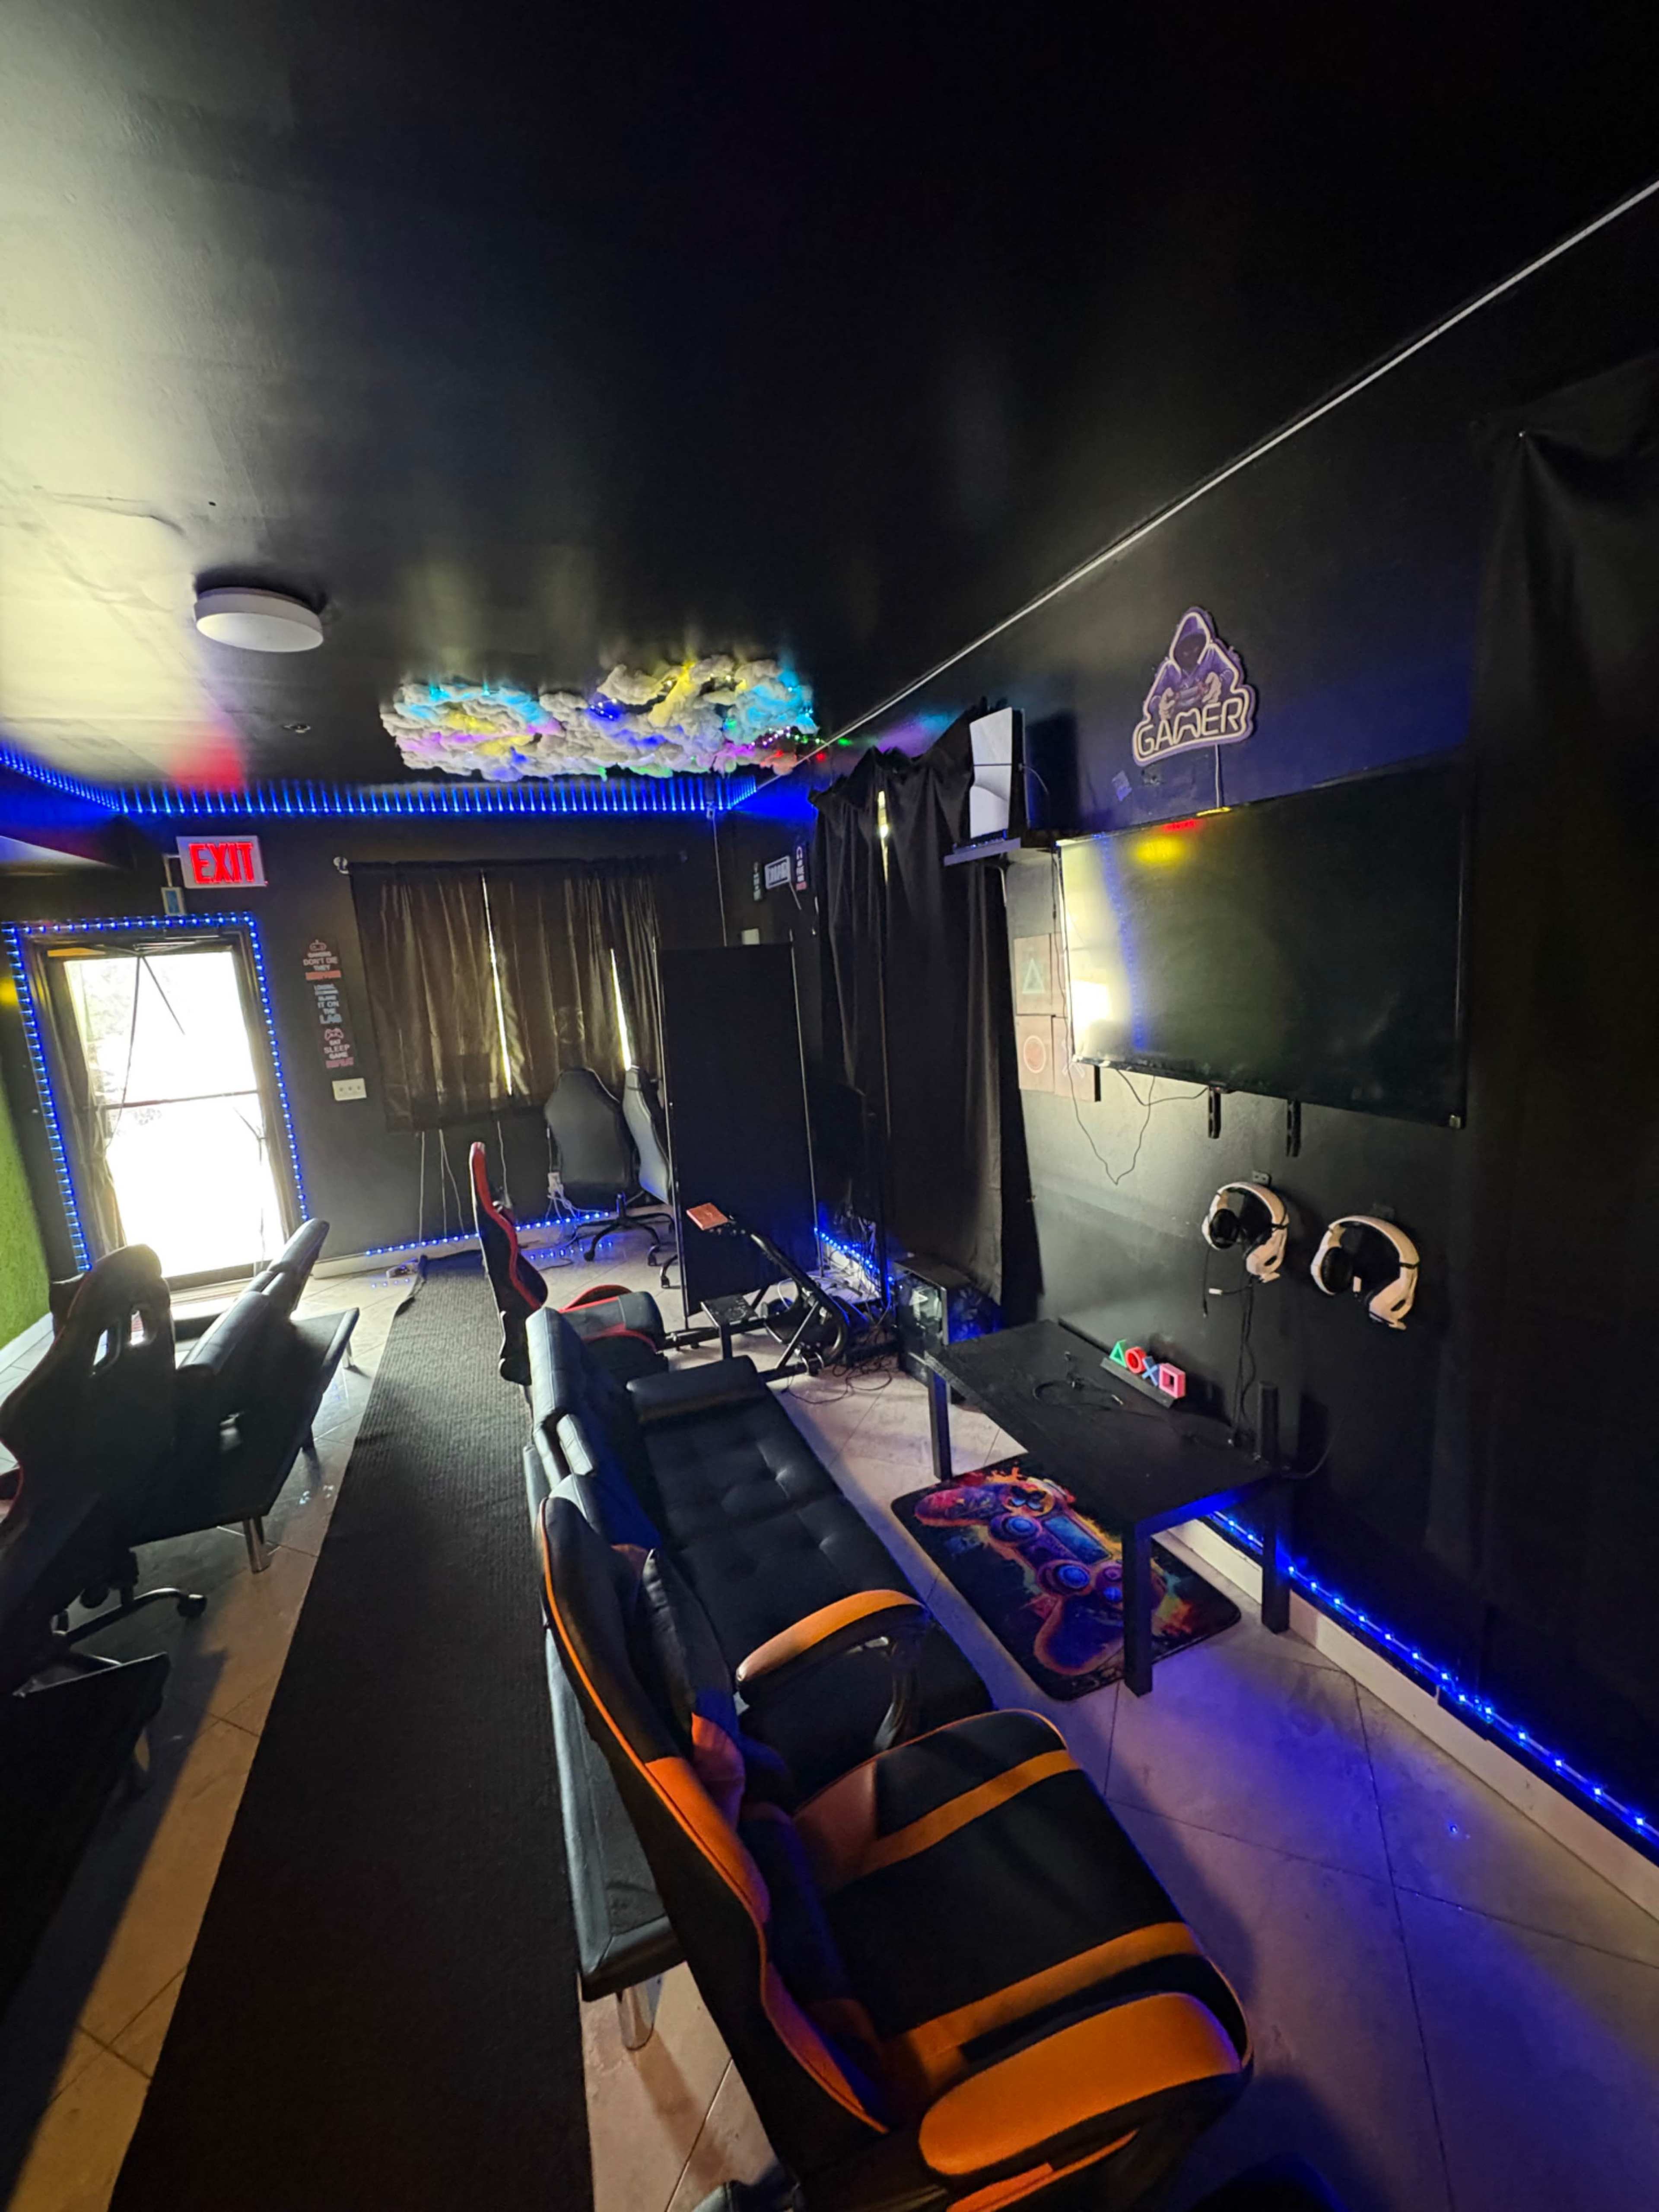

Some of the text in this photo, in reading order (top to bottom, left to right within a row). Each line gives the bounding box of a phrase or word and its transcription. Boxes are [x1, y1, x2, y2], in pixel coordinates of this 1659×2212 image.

[1138, 697, 1243, 755] GAMER
[189, 842, 254, 883] EXIT
[324, 1044, 350, 1054] SLEEP
